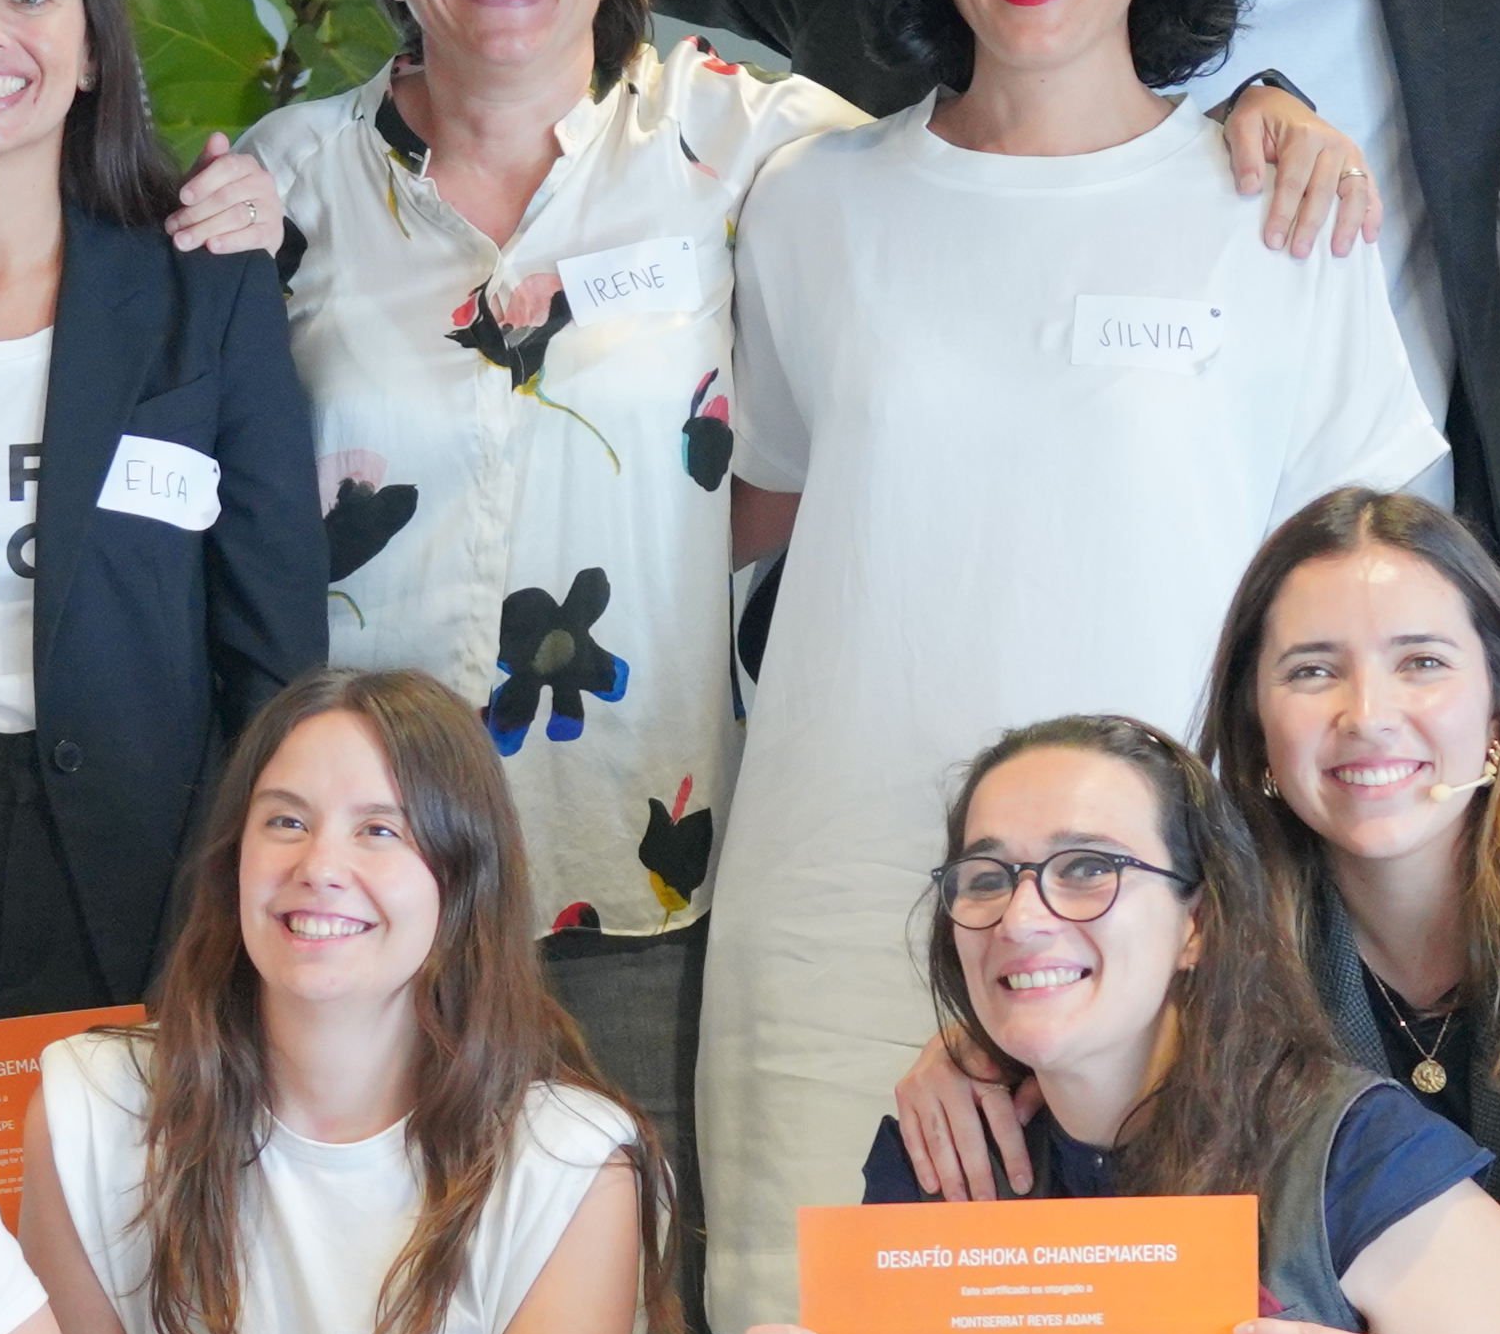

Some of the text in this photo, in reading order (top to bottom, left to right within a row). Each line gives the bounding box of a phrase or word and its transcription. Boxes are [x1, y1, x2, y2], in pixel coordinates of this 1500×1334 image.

[584, 264, 666, 307] IRENE
[1099, 317, 1195, 351] SILVIA
[125, 459, 189, 504] ELSA
[877, 1243, 1178, 1269] DESAFÍO ASHOKA CHANGEMAKERS
[960, 1286, 982, 1297] Este
[981, 1284, 1032, 1296] certificado
[1044, 1283, 1086, 1296] otorgado
